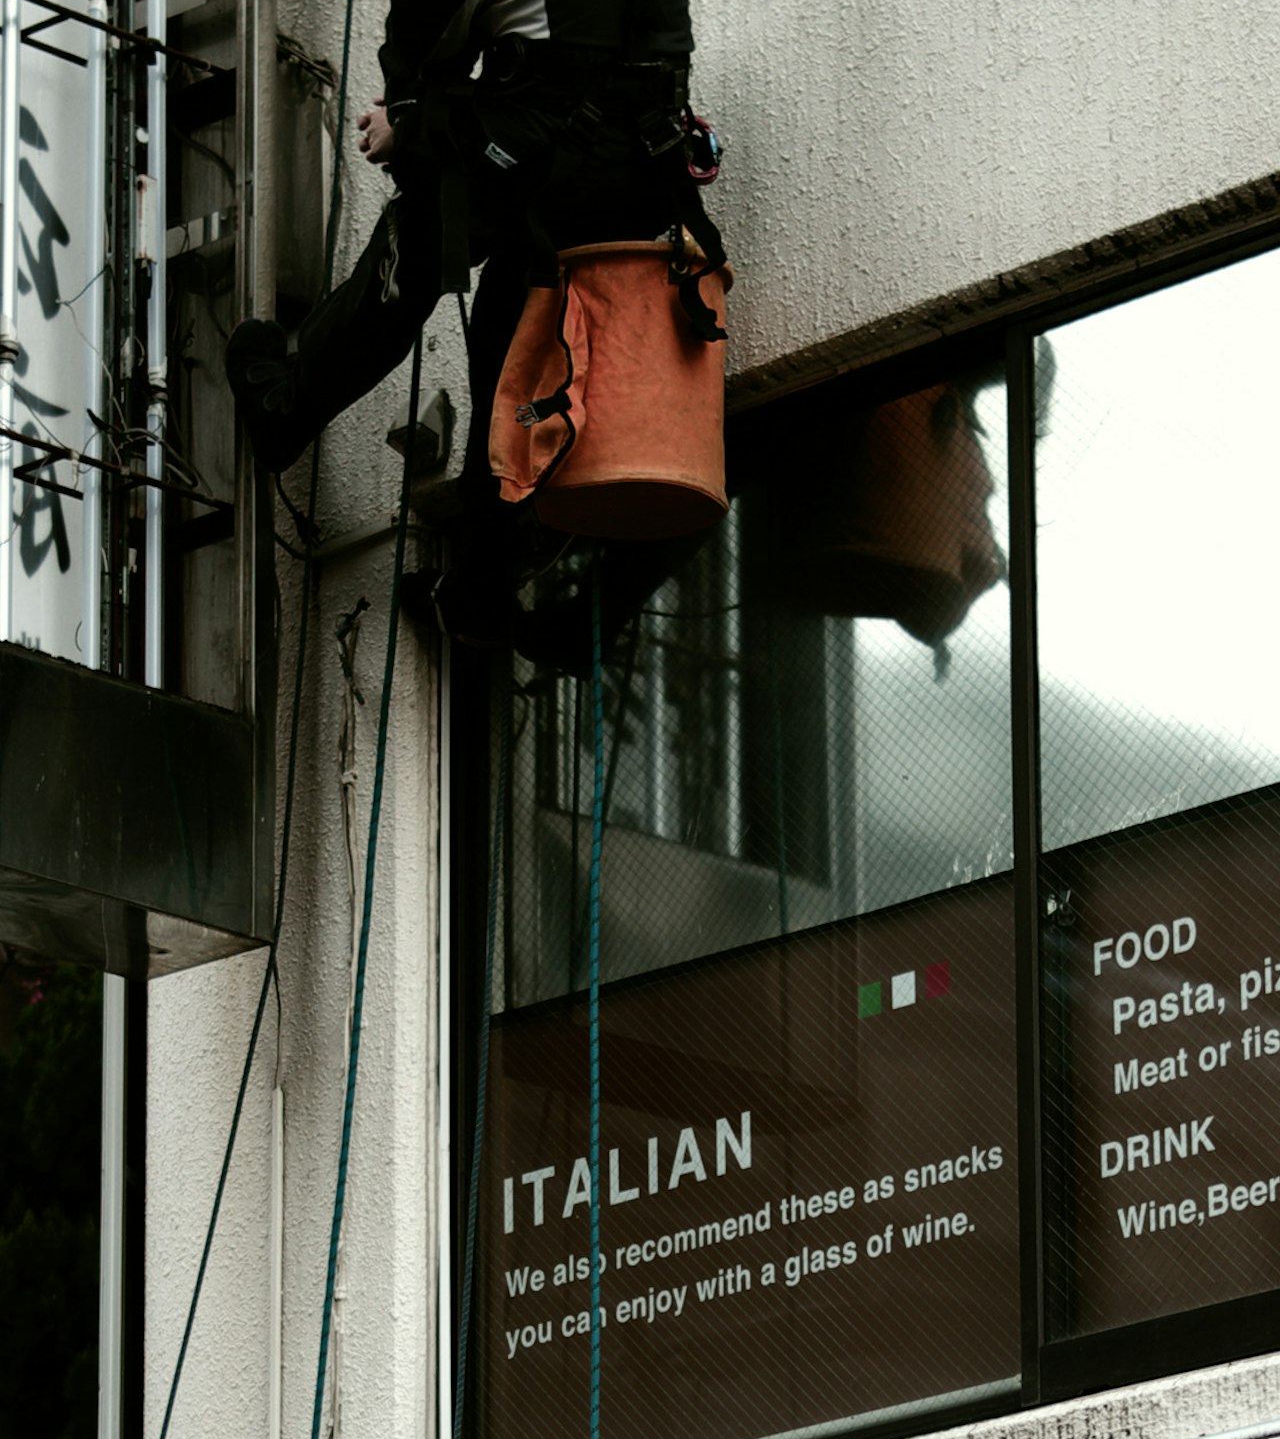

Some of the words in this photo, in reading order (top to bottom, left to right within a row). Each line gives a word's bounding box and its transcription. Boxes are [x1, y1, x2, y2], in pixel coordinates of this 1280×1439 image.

[1092, 915, 1199, 977] FOOD
[1112, 978, 1226, 1035] Pasta,
[1113, 1048, 1189, 1095] Meat
[1197, 1038, 1231, 1071] or
[503, 1110, 753, 1236] ITALIAN
[1100, 1116, 1217, 1179] DRINK
[505, 1267, 545, 1299] We
[552, 1251, 607, 1287] also
[614, 1202, 771, 1272] recommend
[780, 1183, 856, 1226] these
[862, 1173, 896, 1205] as
[903, 1142, 1005, 1195] snacks
[505, 1321, 553, 1359] you
[560, 1304, 607, 1338] can
[615, 1281, 688, 1323] enjoy
[695, 1260, 752, 1304] with
[760, 1263, 777, 1287] a
[784, 1237, 858, 1288] glass
[866, 1223, 895, 1261] of
[901, 1211, 976, 1250] wine.
